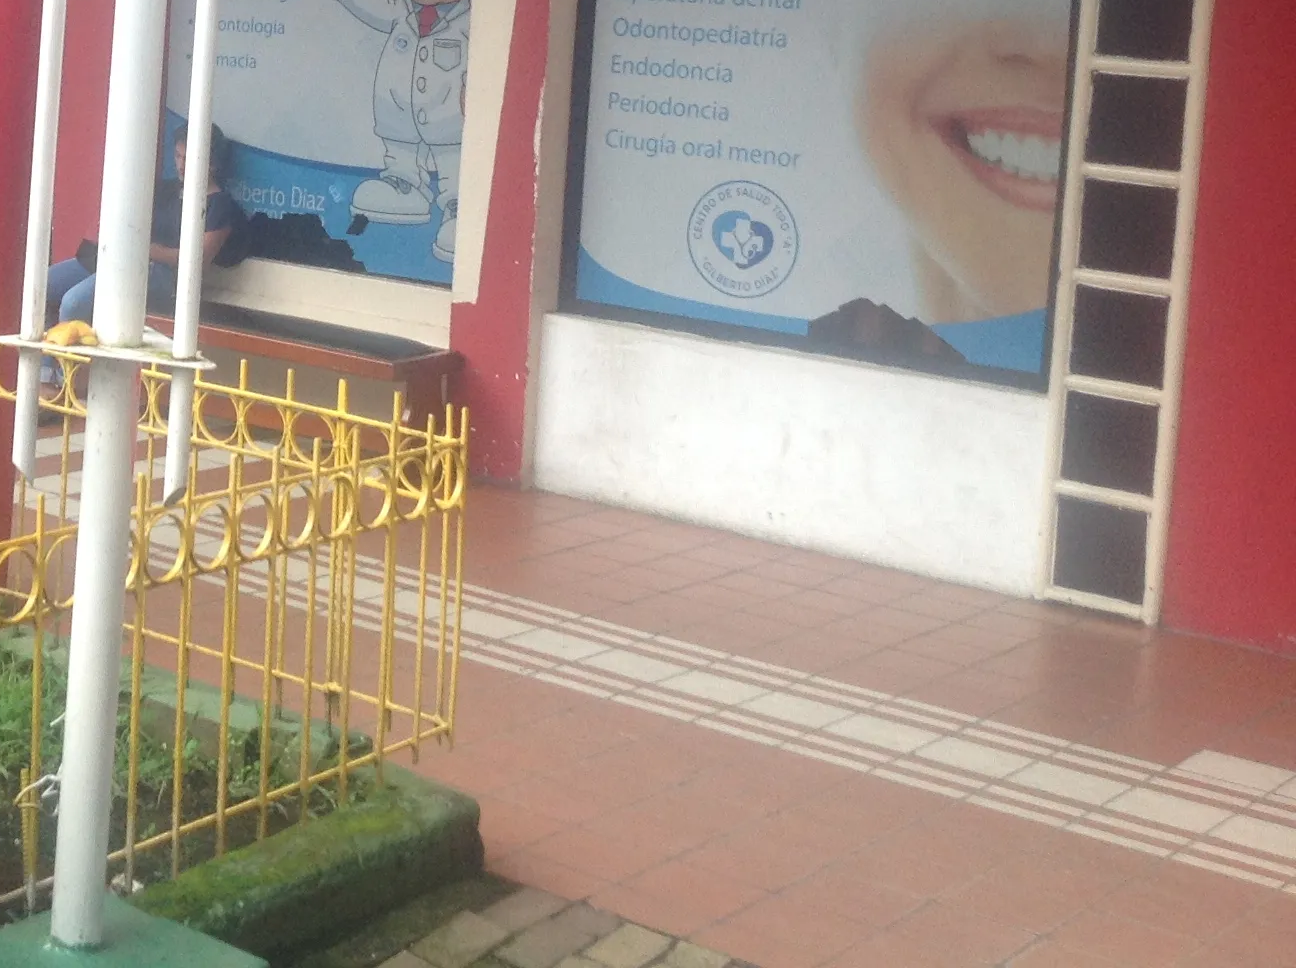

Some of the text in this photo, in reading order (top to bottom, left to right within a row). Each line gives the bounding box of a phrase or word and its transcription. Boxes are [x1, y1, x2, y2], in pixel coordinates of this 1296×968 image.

[216, 54, 257, 69] macia
[610, 54, 733, 83] Endodoncia
[607, 92, 729, 122] Periodoncia
[682, 139, 722, 159] oral
[728, 144, 802, 168] menor
